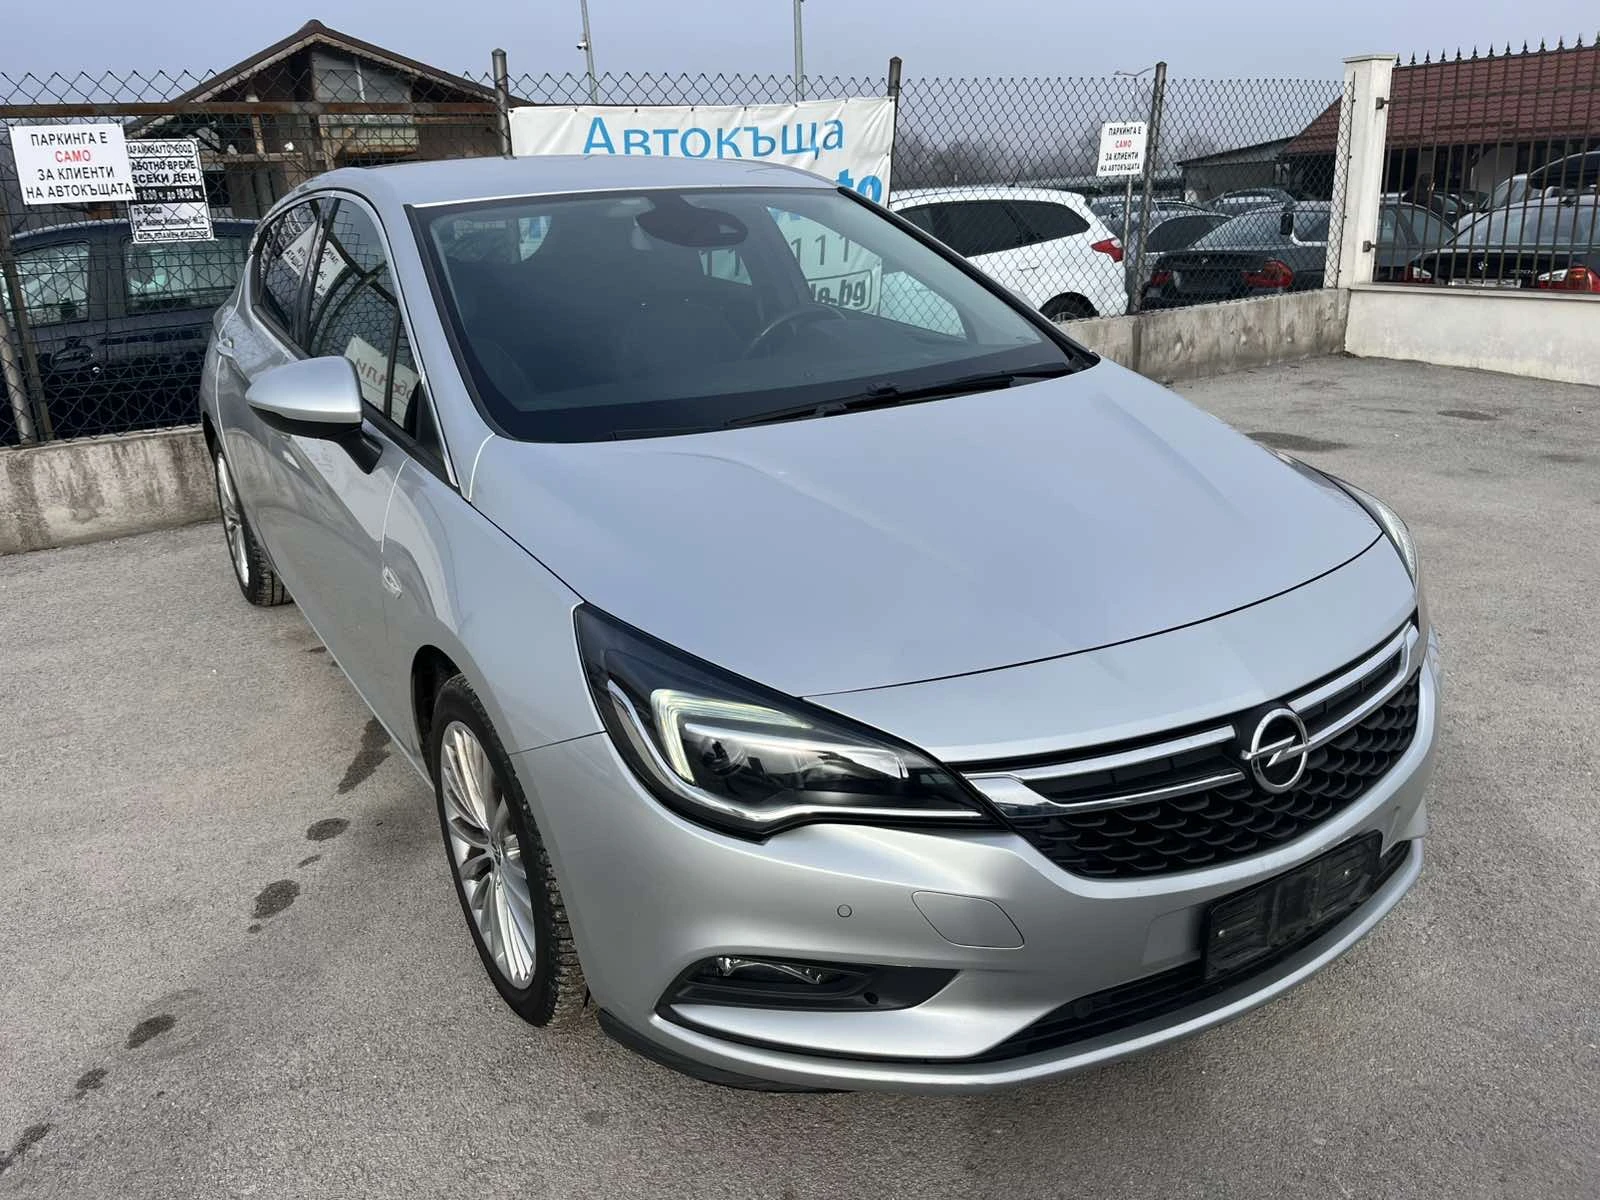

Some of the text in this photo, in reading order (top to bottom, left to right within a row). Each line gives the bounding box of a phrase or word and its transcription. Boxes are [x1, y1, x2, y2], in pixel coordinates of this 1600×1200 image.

[1108, 126, 1142, 136] ПАРКИНГА Е
[31, 131, 108, 146] ПАРКИНГА Е
[583, 115, 844, 160] Автокъща
[1114, 140, 1133, 148] САМО
[55, 150, 91, 163] САМО
[1105, 151, 1139, 161] ЗА КЛИЕНТИ
[131, 160, 197, 171] АБОТНО ВРЕМЕ
[1108, 163, 1140, 172] АВТОКЪЩАТА
[38, 167, 114, 181] ЗА КЛИЕНТИ
[131, 173, 197, 184] ВСЕКИ ДЕН
[26, 182, 134, 199] НА АВТОКЪЩАТА
